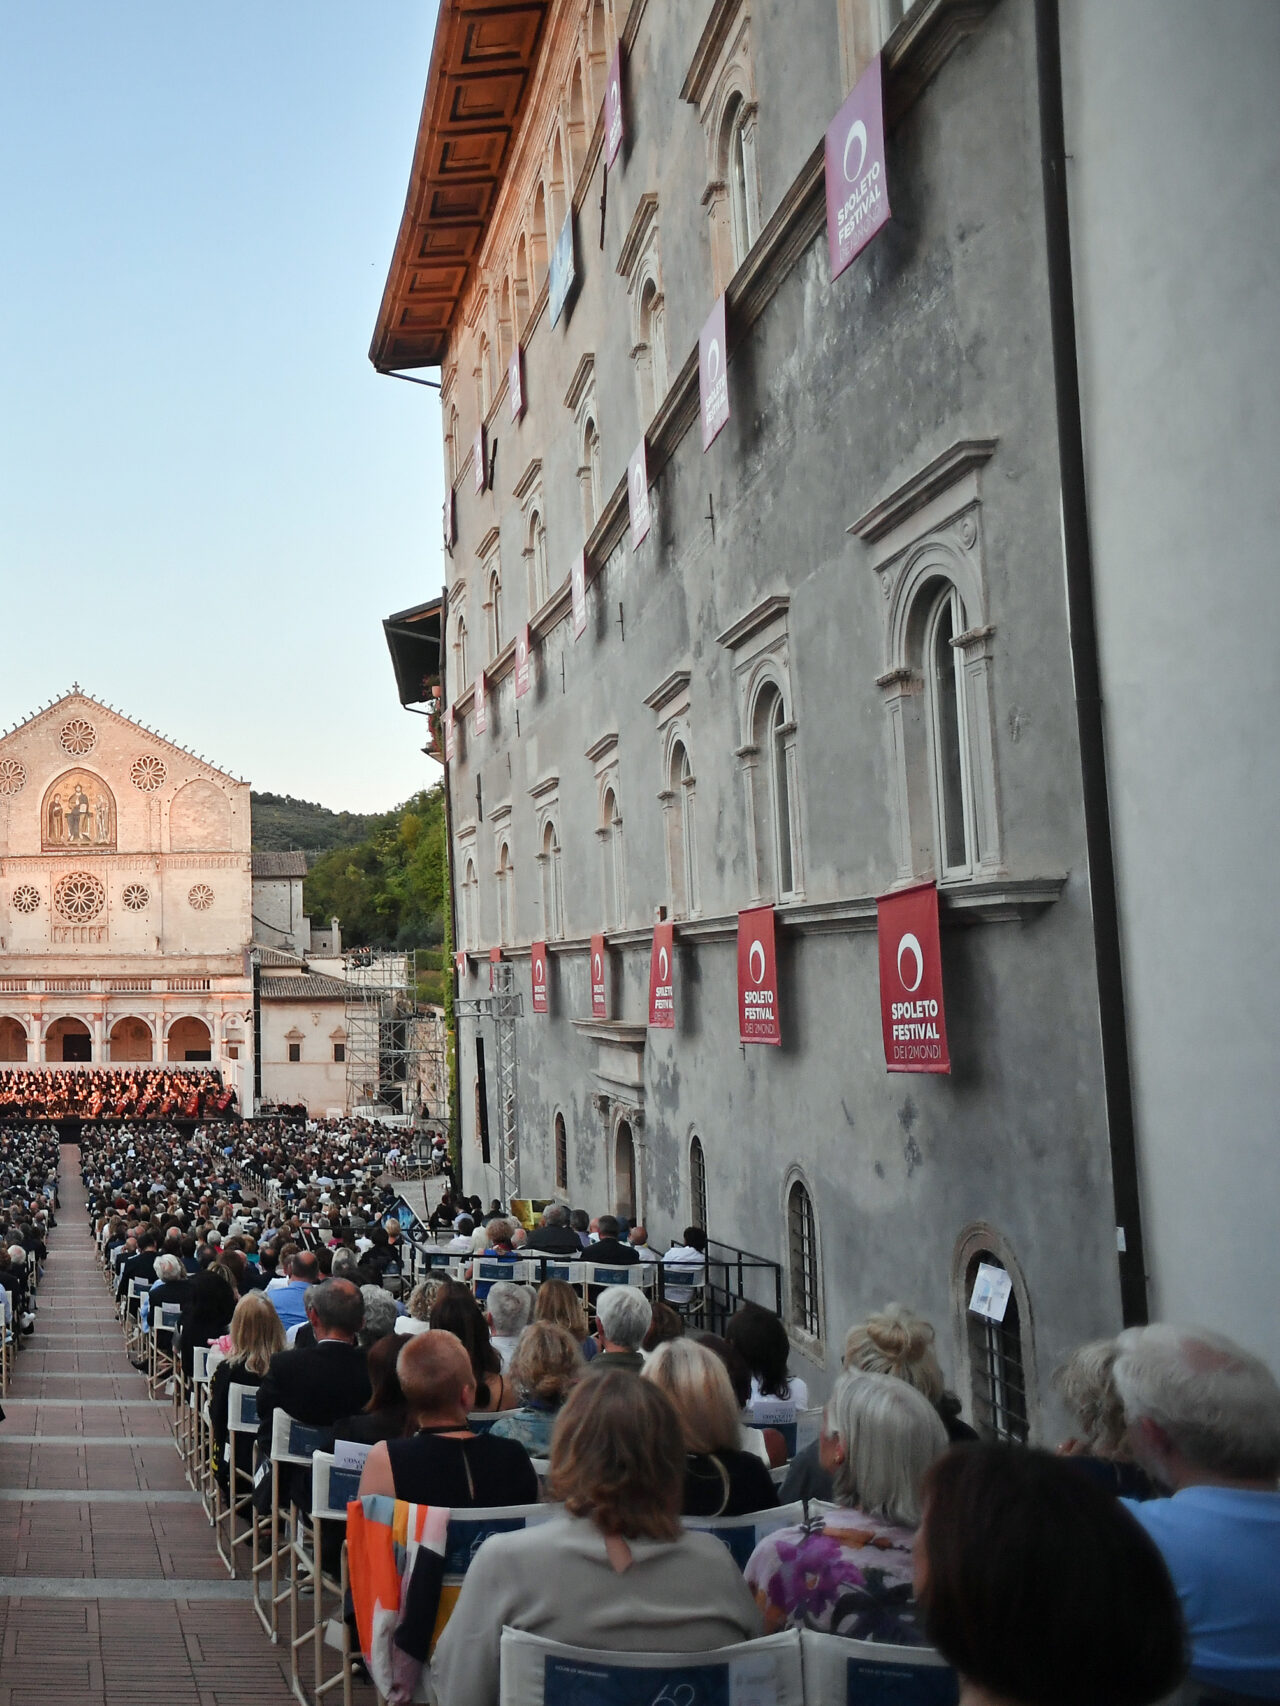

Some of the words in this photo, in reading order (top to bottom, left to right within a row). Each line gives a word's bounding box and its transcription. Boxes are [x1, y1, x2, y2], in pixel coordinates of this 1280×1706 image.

[838, 160, 880, 226] SPOLETO
[839, 184, 881, 245] FESTIVAL
[744, 990, 774, 1004] SPOLETO
[744, 1007, 775, 1020] FESTIVAL
[891, 999, 938, 1020] SPOLETO
[892, 1022, 940, 1041] FESTIVAL
[893, 1045, 907, 1059] DEI
[908, 1044, 942, 1059] 2MONDI
